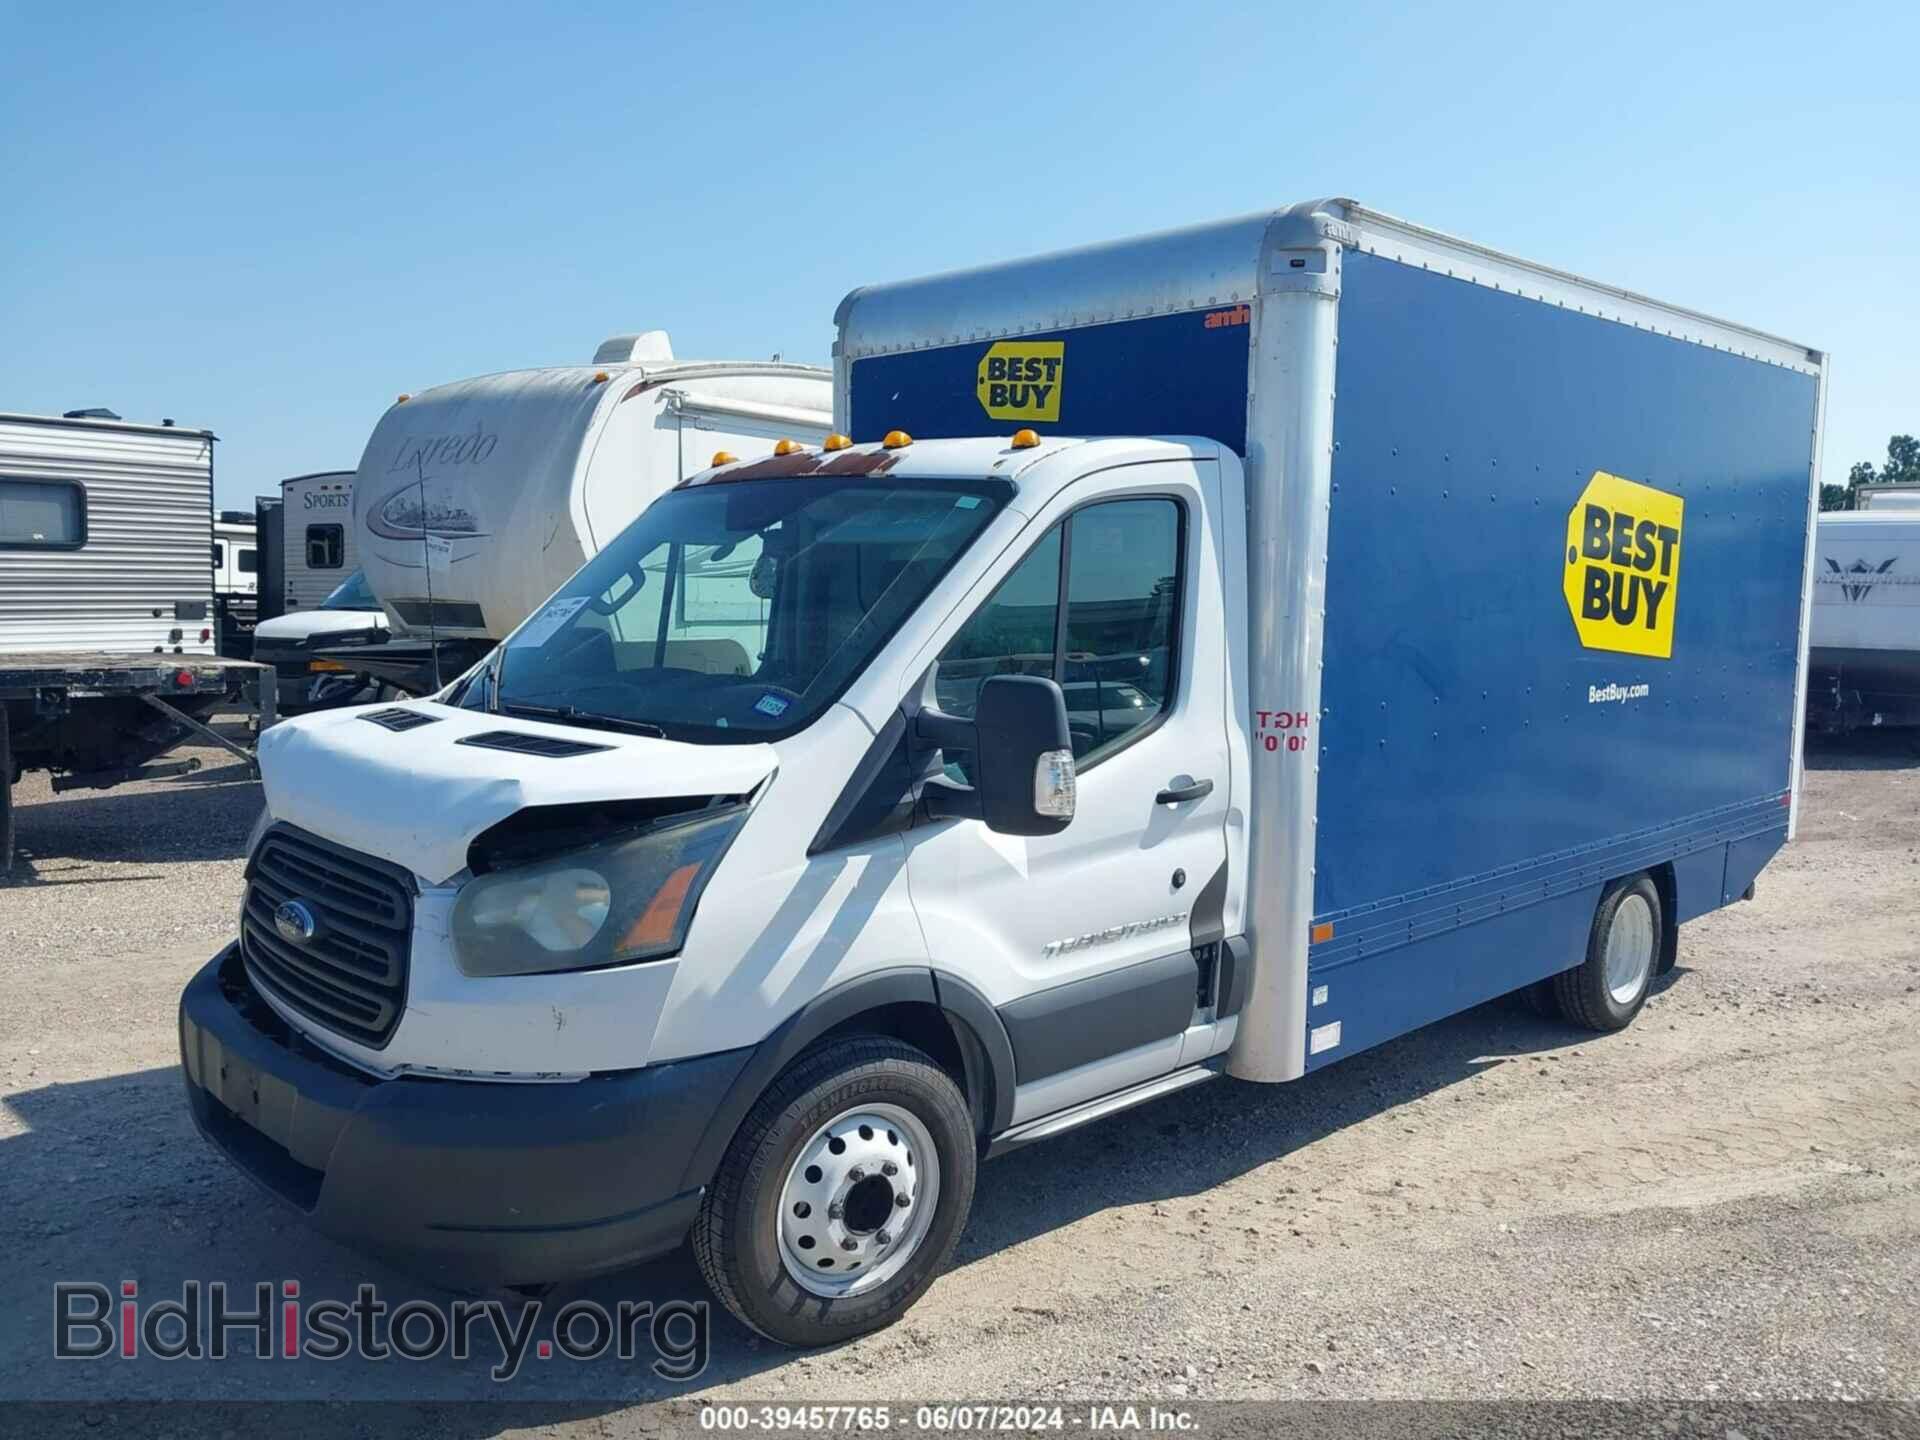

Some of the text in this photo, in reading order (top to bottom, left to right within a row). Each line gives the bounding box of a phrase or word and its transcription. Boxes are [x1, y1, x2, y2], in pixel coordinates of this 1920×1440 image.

[988, 357, 1061, 382] BEST
[989, 383, 1053, 409] BUY
[386, 421, 498, 474] Laredo
[1582, 503, 1679, 577] BEST
[1582, 565, 1669, 630] BUY
[1588, 682, 1649, 704] BestBuy.com
